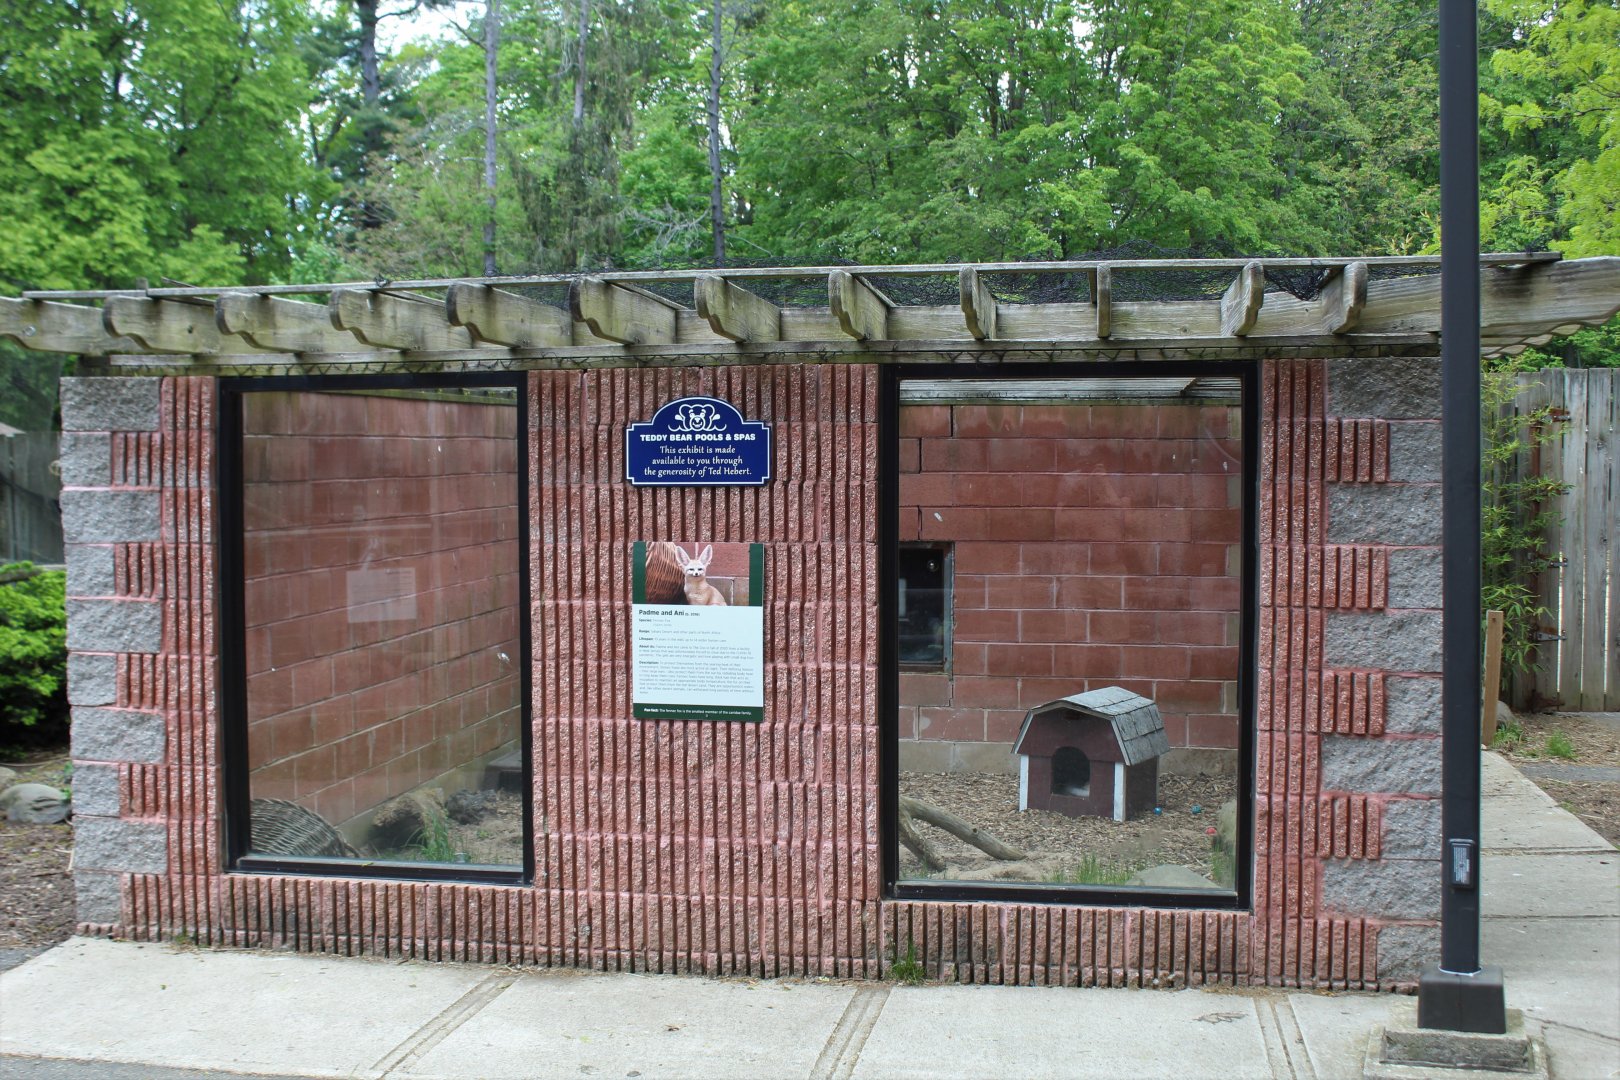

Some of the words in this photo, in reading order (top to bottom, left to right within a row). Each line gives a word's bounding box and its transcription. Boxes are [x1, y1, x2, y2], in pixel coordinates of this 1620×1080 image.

[659, 445, 676, 454] This
[677, 445, 704, 454] exhibit
[706, 445, 713, 454] is
[715, 445, 736, 454] made
[652, 456, 685, 465] available
[687, 457, 694, 465] to
[696, 458, 710, 466] you
[712, 456, 743, 467] through
[644, 467, 656, 476] the
[657, 467, 697, 478] generosity
[698, 466, 707, 477] of
[707, 466, 722, 475] Ted
[723, 466, 752, 475] Hebert.
